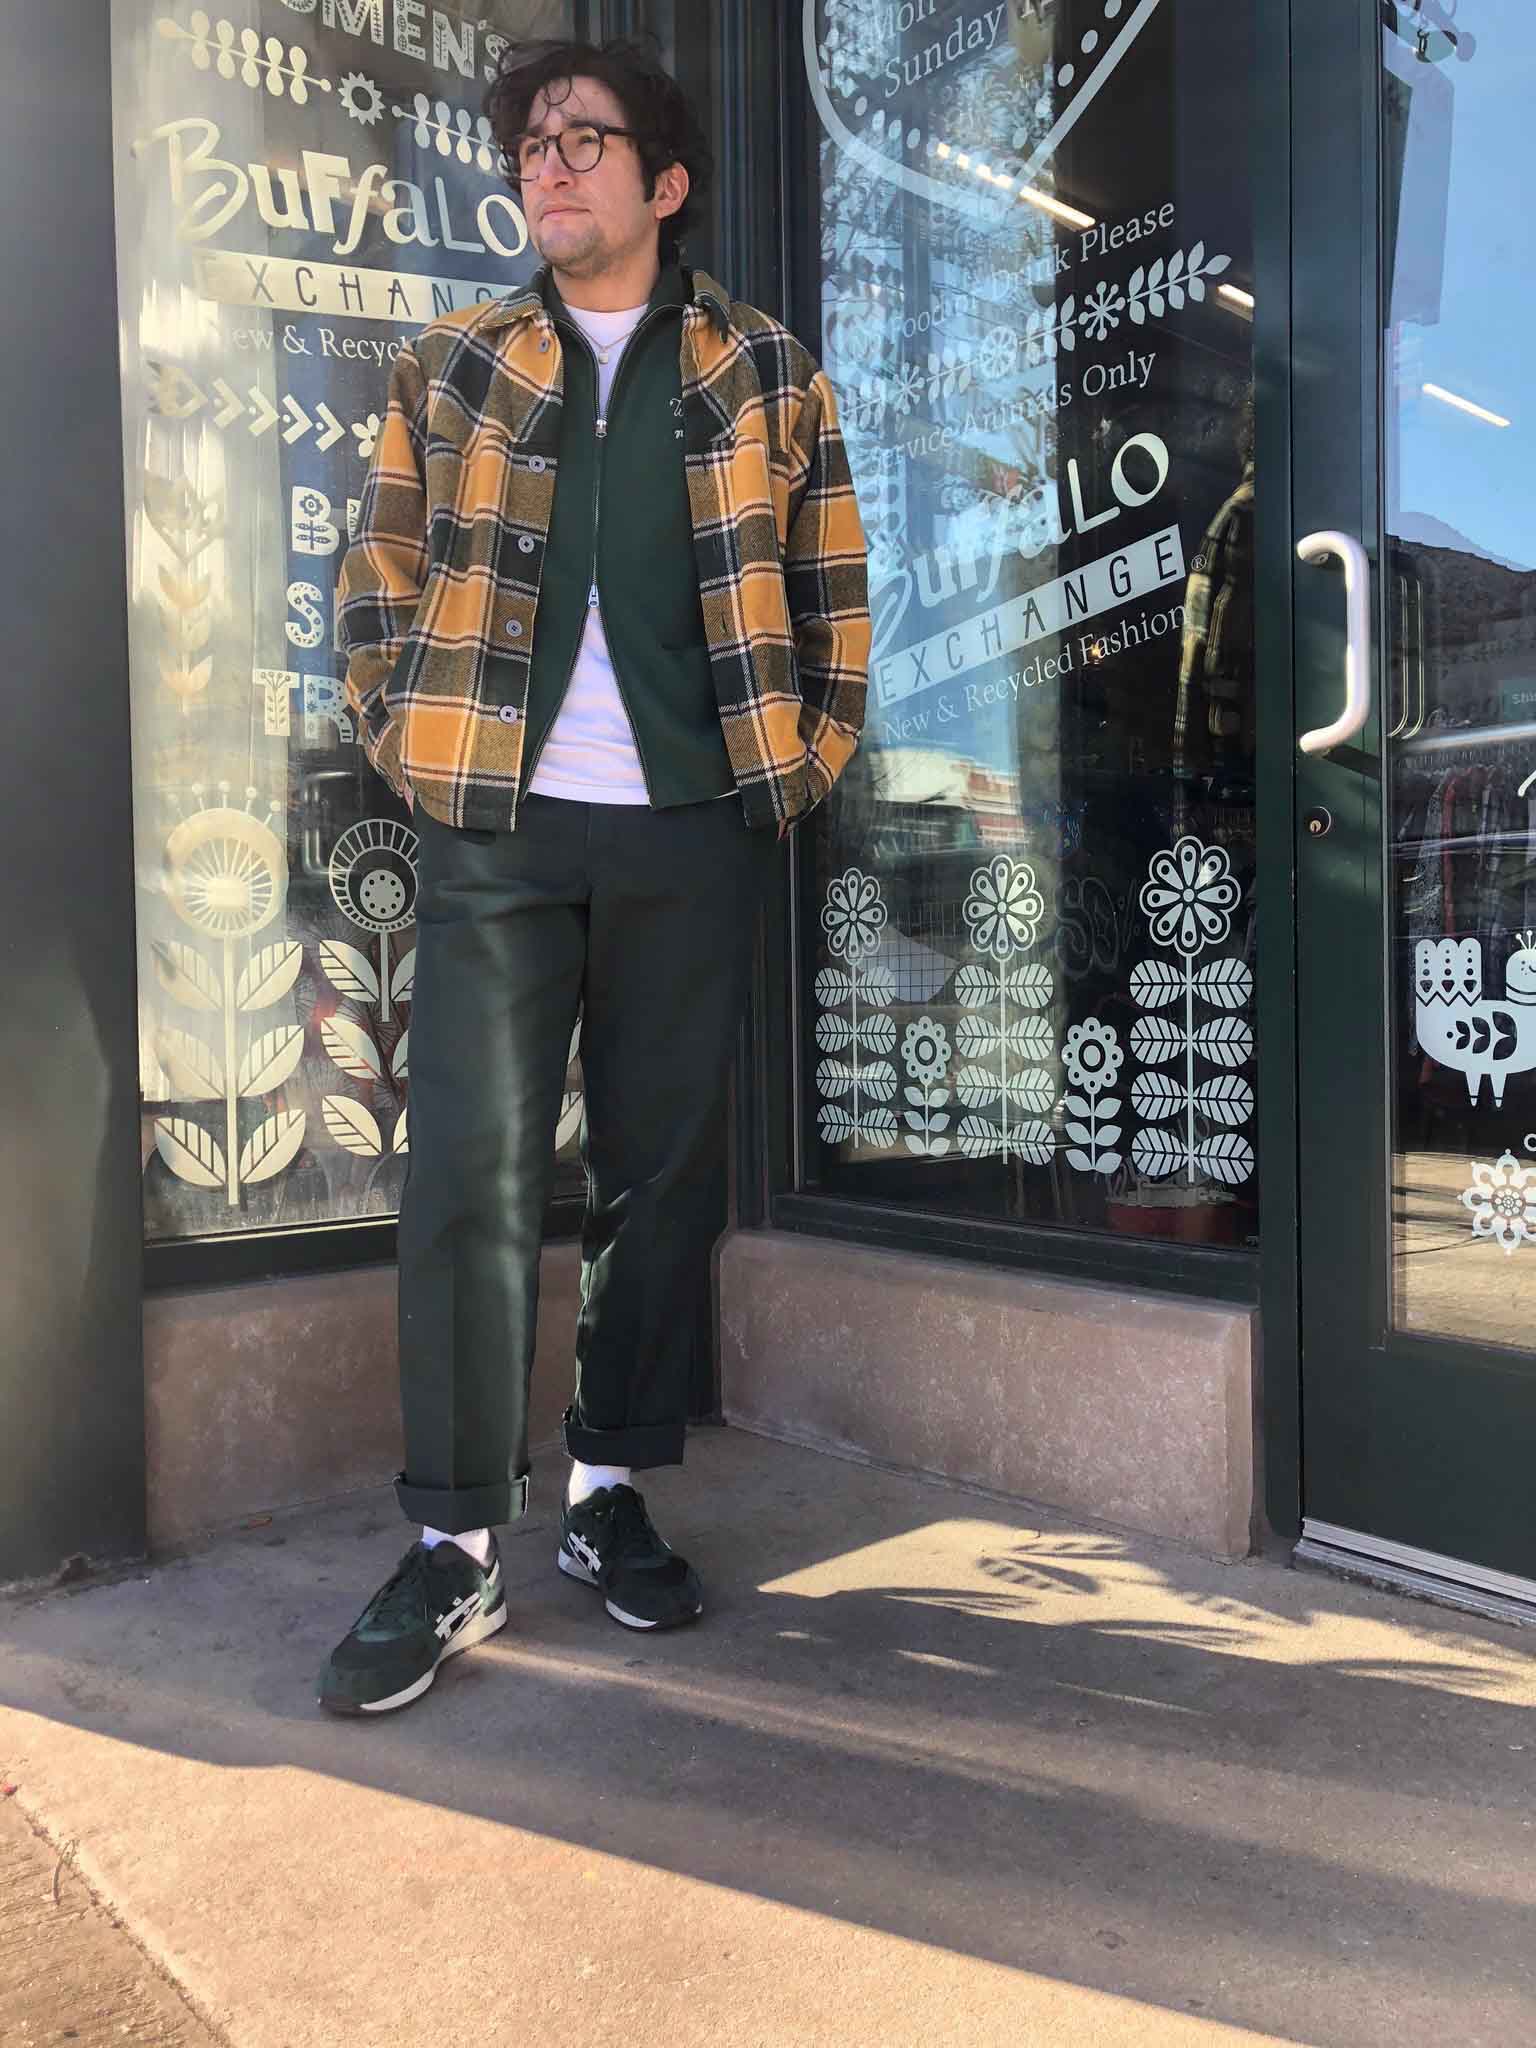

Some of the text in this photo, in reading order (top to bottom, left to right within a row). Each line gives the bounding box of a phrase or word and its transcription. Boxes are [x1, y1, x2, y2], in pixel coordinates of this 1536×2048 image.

[885, 4, 1005, 98] Sunday
[1080, 203, 1174, 262] Please
[283, 325, 312, 355] &
[1083, 350, 1156, 396] Only
[879, 533, 1178, 701] EXCHANGE
[882, 604, 1186, 745] New & Recycled Fashion
